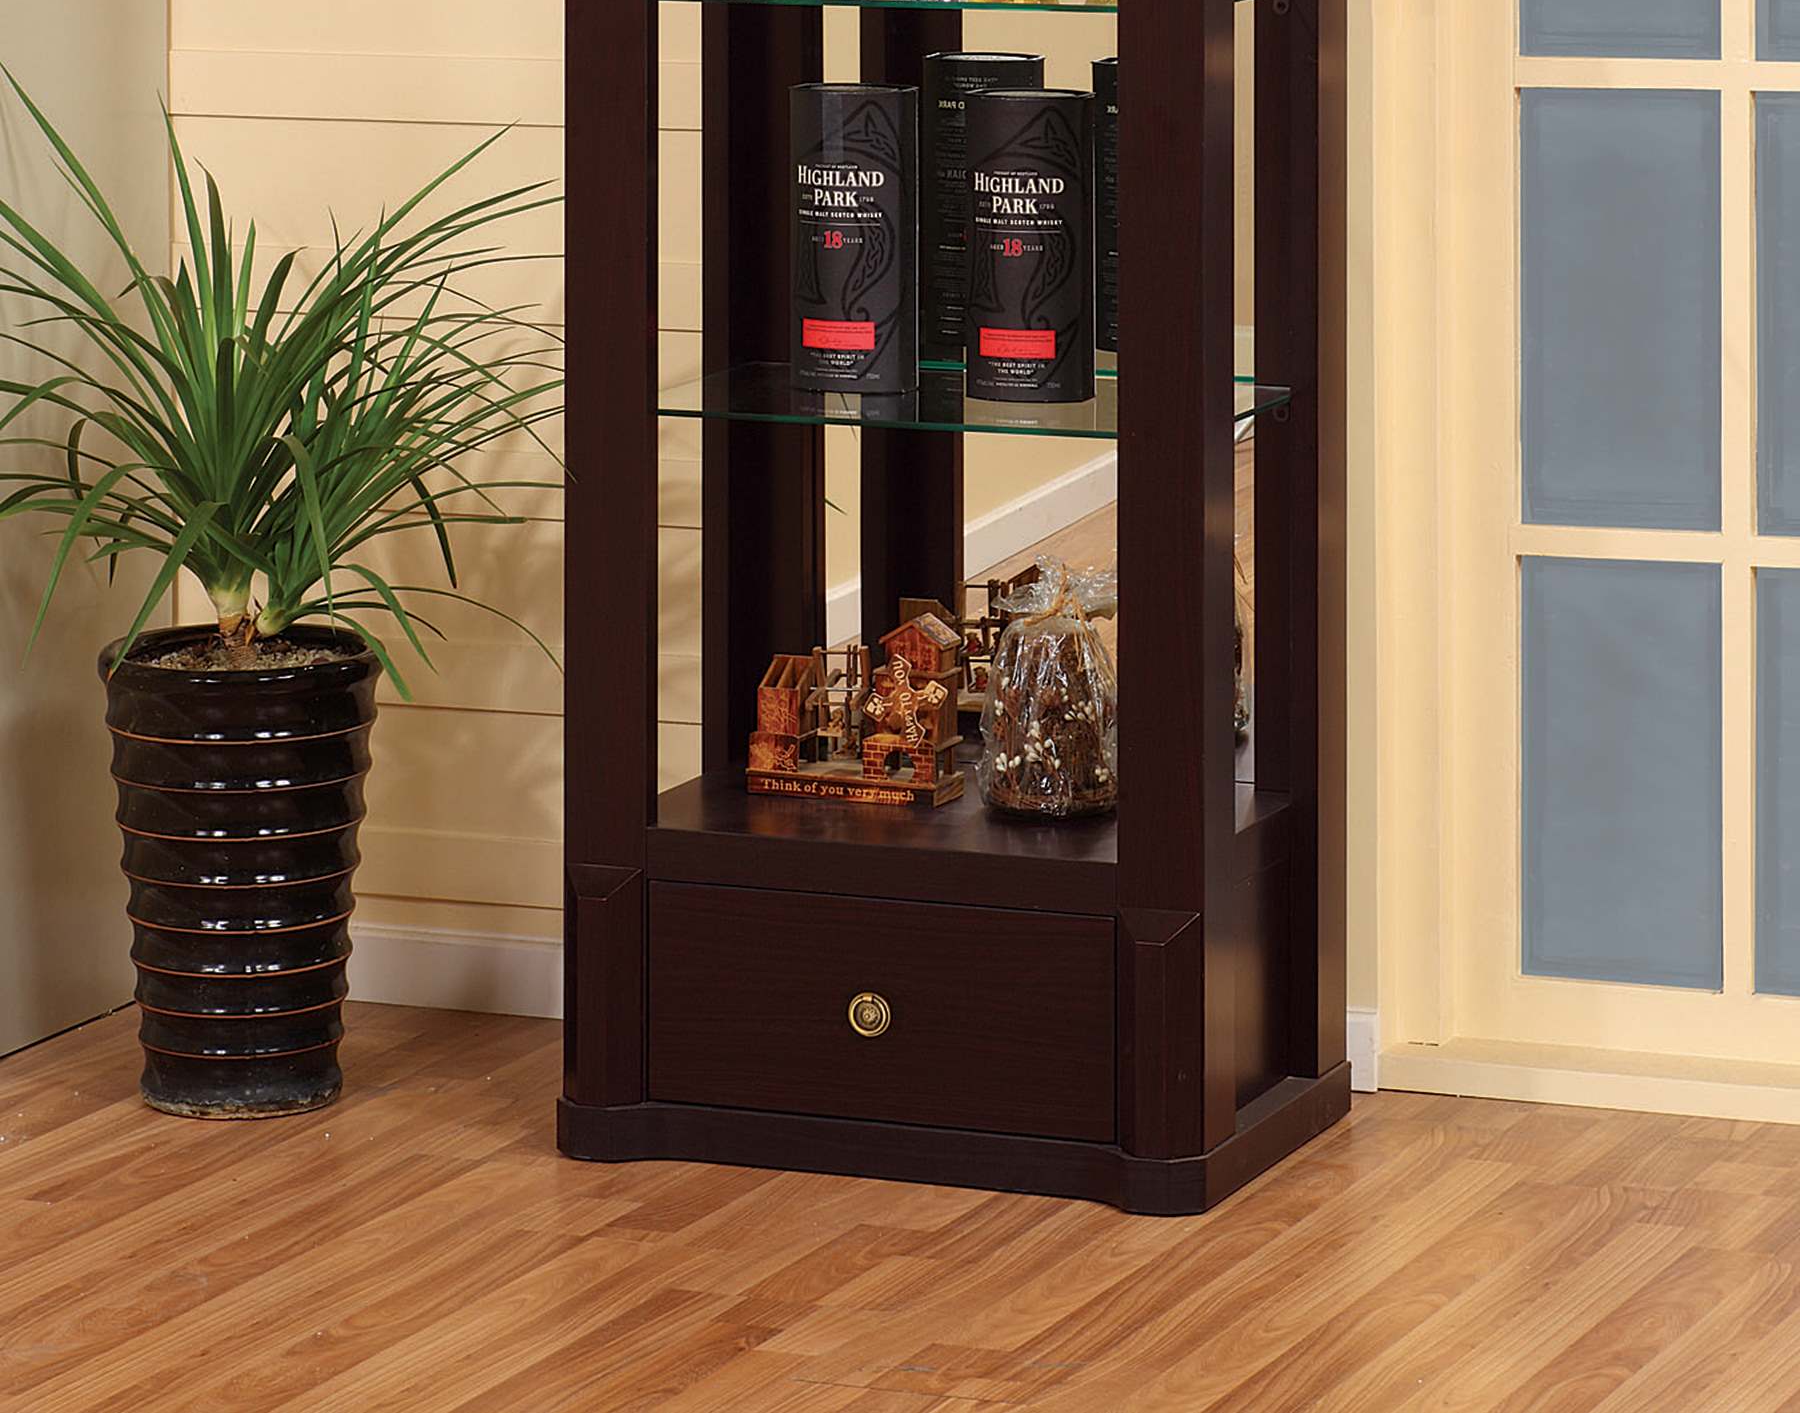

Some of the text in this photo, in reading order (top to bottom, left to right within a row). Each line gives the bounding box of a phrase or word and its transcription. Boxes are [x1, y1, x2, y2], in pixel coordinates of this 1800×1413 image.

[798, 164, 885, 187] HIGHLAND
[974, 171, 1065, 194] HIGHLAND
[814, 188, 859, 207] PARK
[992, 195, 1039, 215] PARK
[824, 230, 843, 249] 18
[1003, 237, 1023, 257] 18
[892, 660, 906, 685] YOU
[761, 778, 915, 802] Think of you very much
